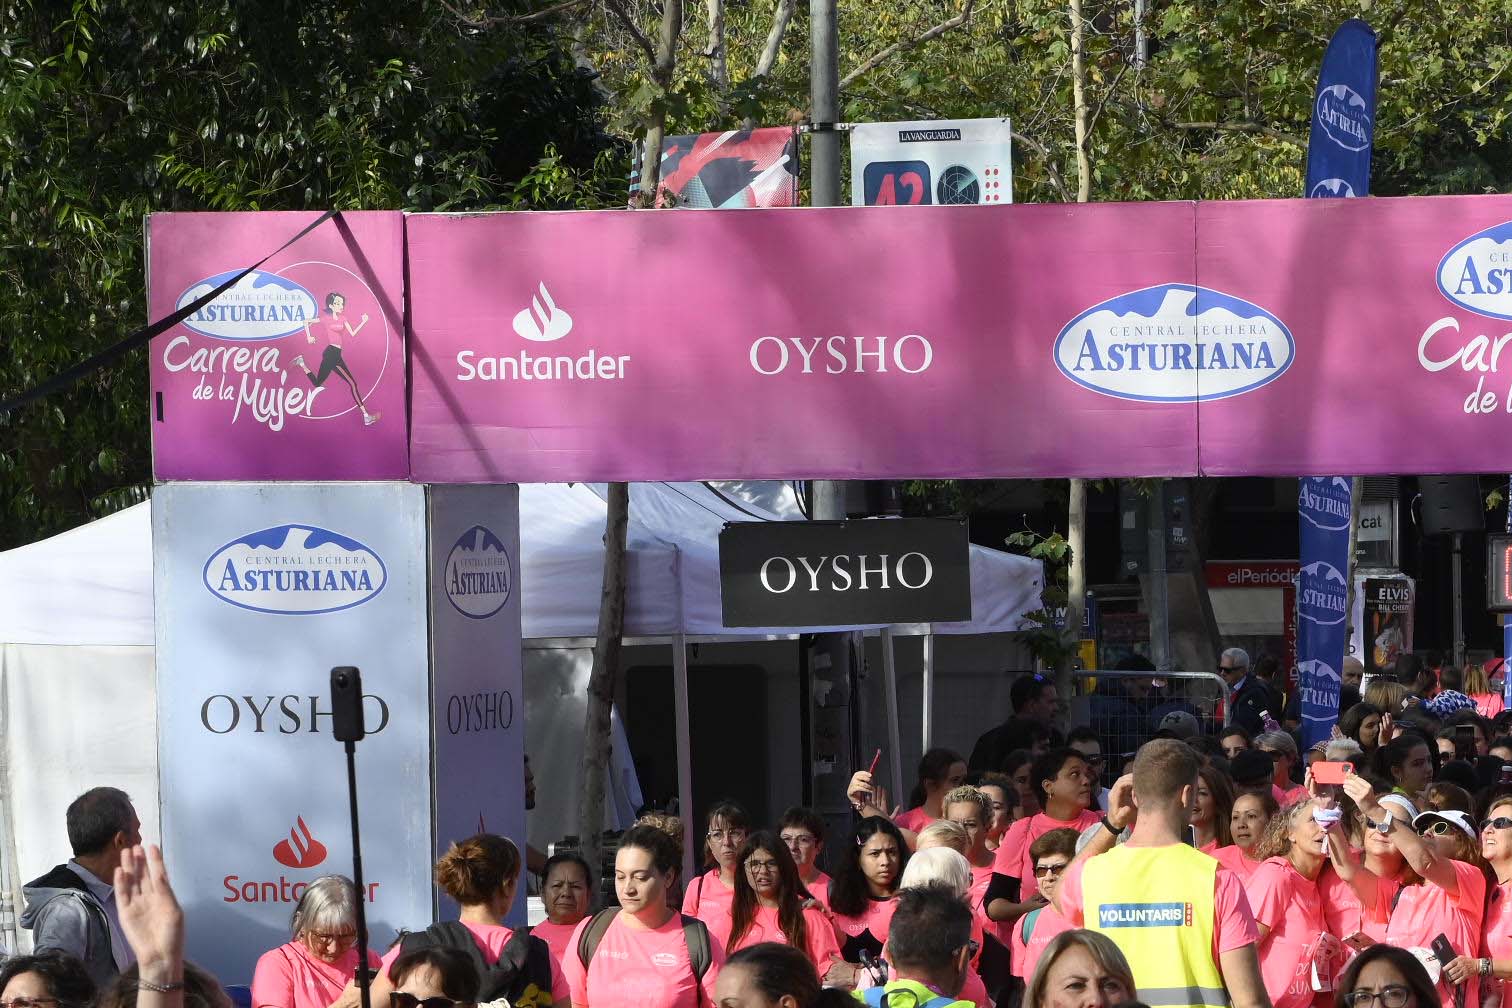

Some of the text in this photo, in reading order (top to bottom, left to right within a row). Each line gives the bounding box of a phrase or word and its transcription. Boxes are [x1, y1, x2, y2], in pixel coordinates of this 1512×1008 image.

[910, 130, 959, 140] VANGUARDIA
[208, 292, 254, 302] ENTRAL
[1109, 323, 1267, 337] CENTRAL LECHERA
[163, 335, 280, 374] Carrera
[457, 349, 631, 382] Santander
[749, 334, 934, 375] OYSHO
[1073, 328, 1277, 373] ASTURIANA
[192, 370, 325, 432] de la Mujer
[1463, 374, 1498, 414] de
[218, 558, 373, 593] ASTURIANA
[245, 555, 368, 565] CENTRAL LECHERA
[760, 552, 933, 594] OYSHO
[450, 566, 508, 596] ASTURIANA
[1378, 587, 1409, 600] ELVIS
[446, 690, 513, 736] OYSHO
[223, 875, 380, 903] Santaer
[1100, 908, 1182, 922] VOLUNTARIS
